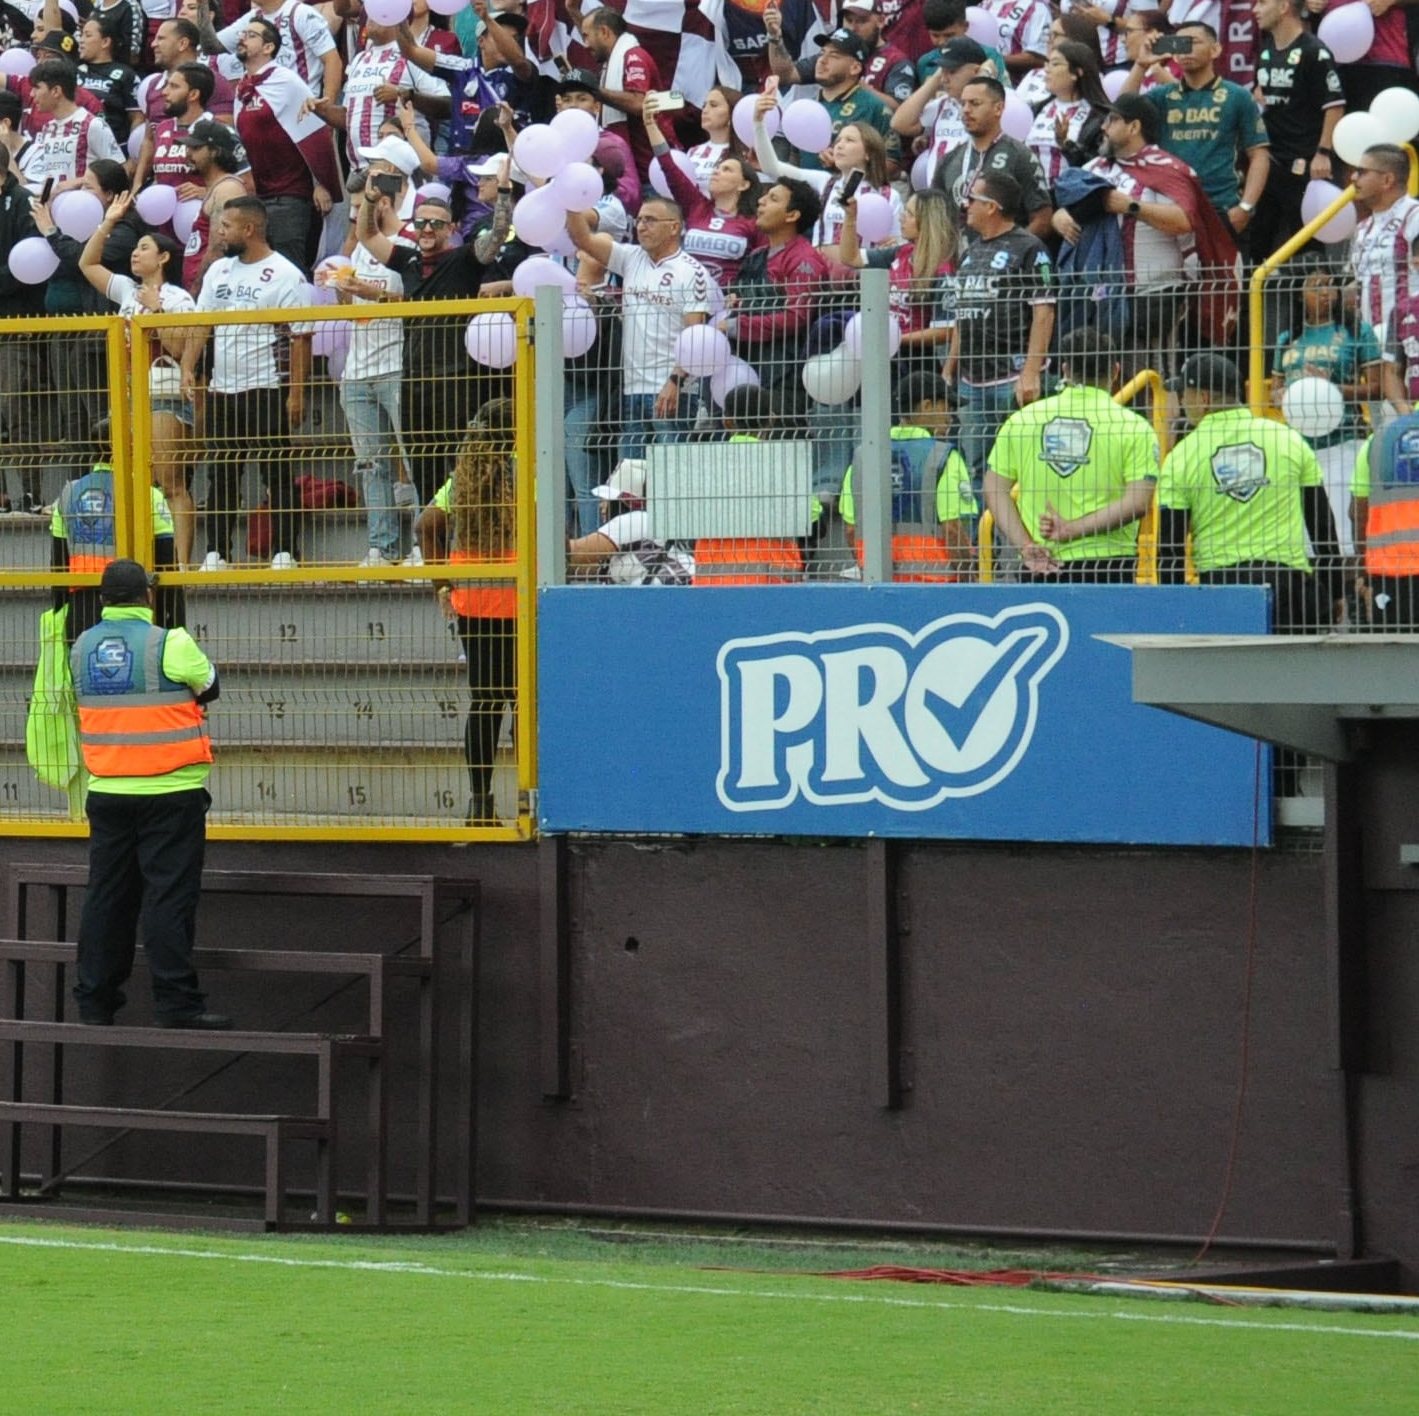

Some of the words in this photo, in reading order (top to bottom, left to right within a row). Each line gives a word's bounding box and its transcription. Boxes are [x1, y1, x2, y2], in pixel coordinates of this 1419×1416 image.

[1184, 105, 1221, 124] BAC
[259, 267, 275, 283] S
[236, 286, 261, 301] BAC
